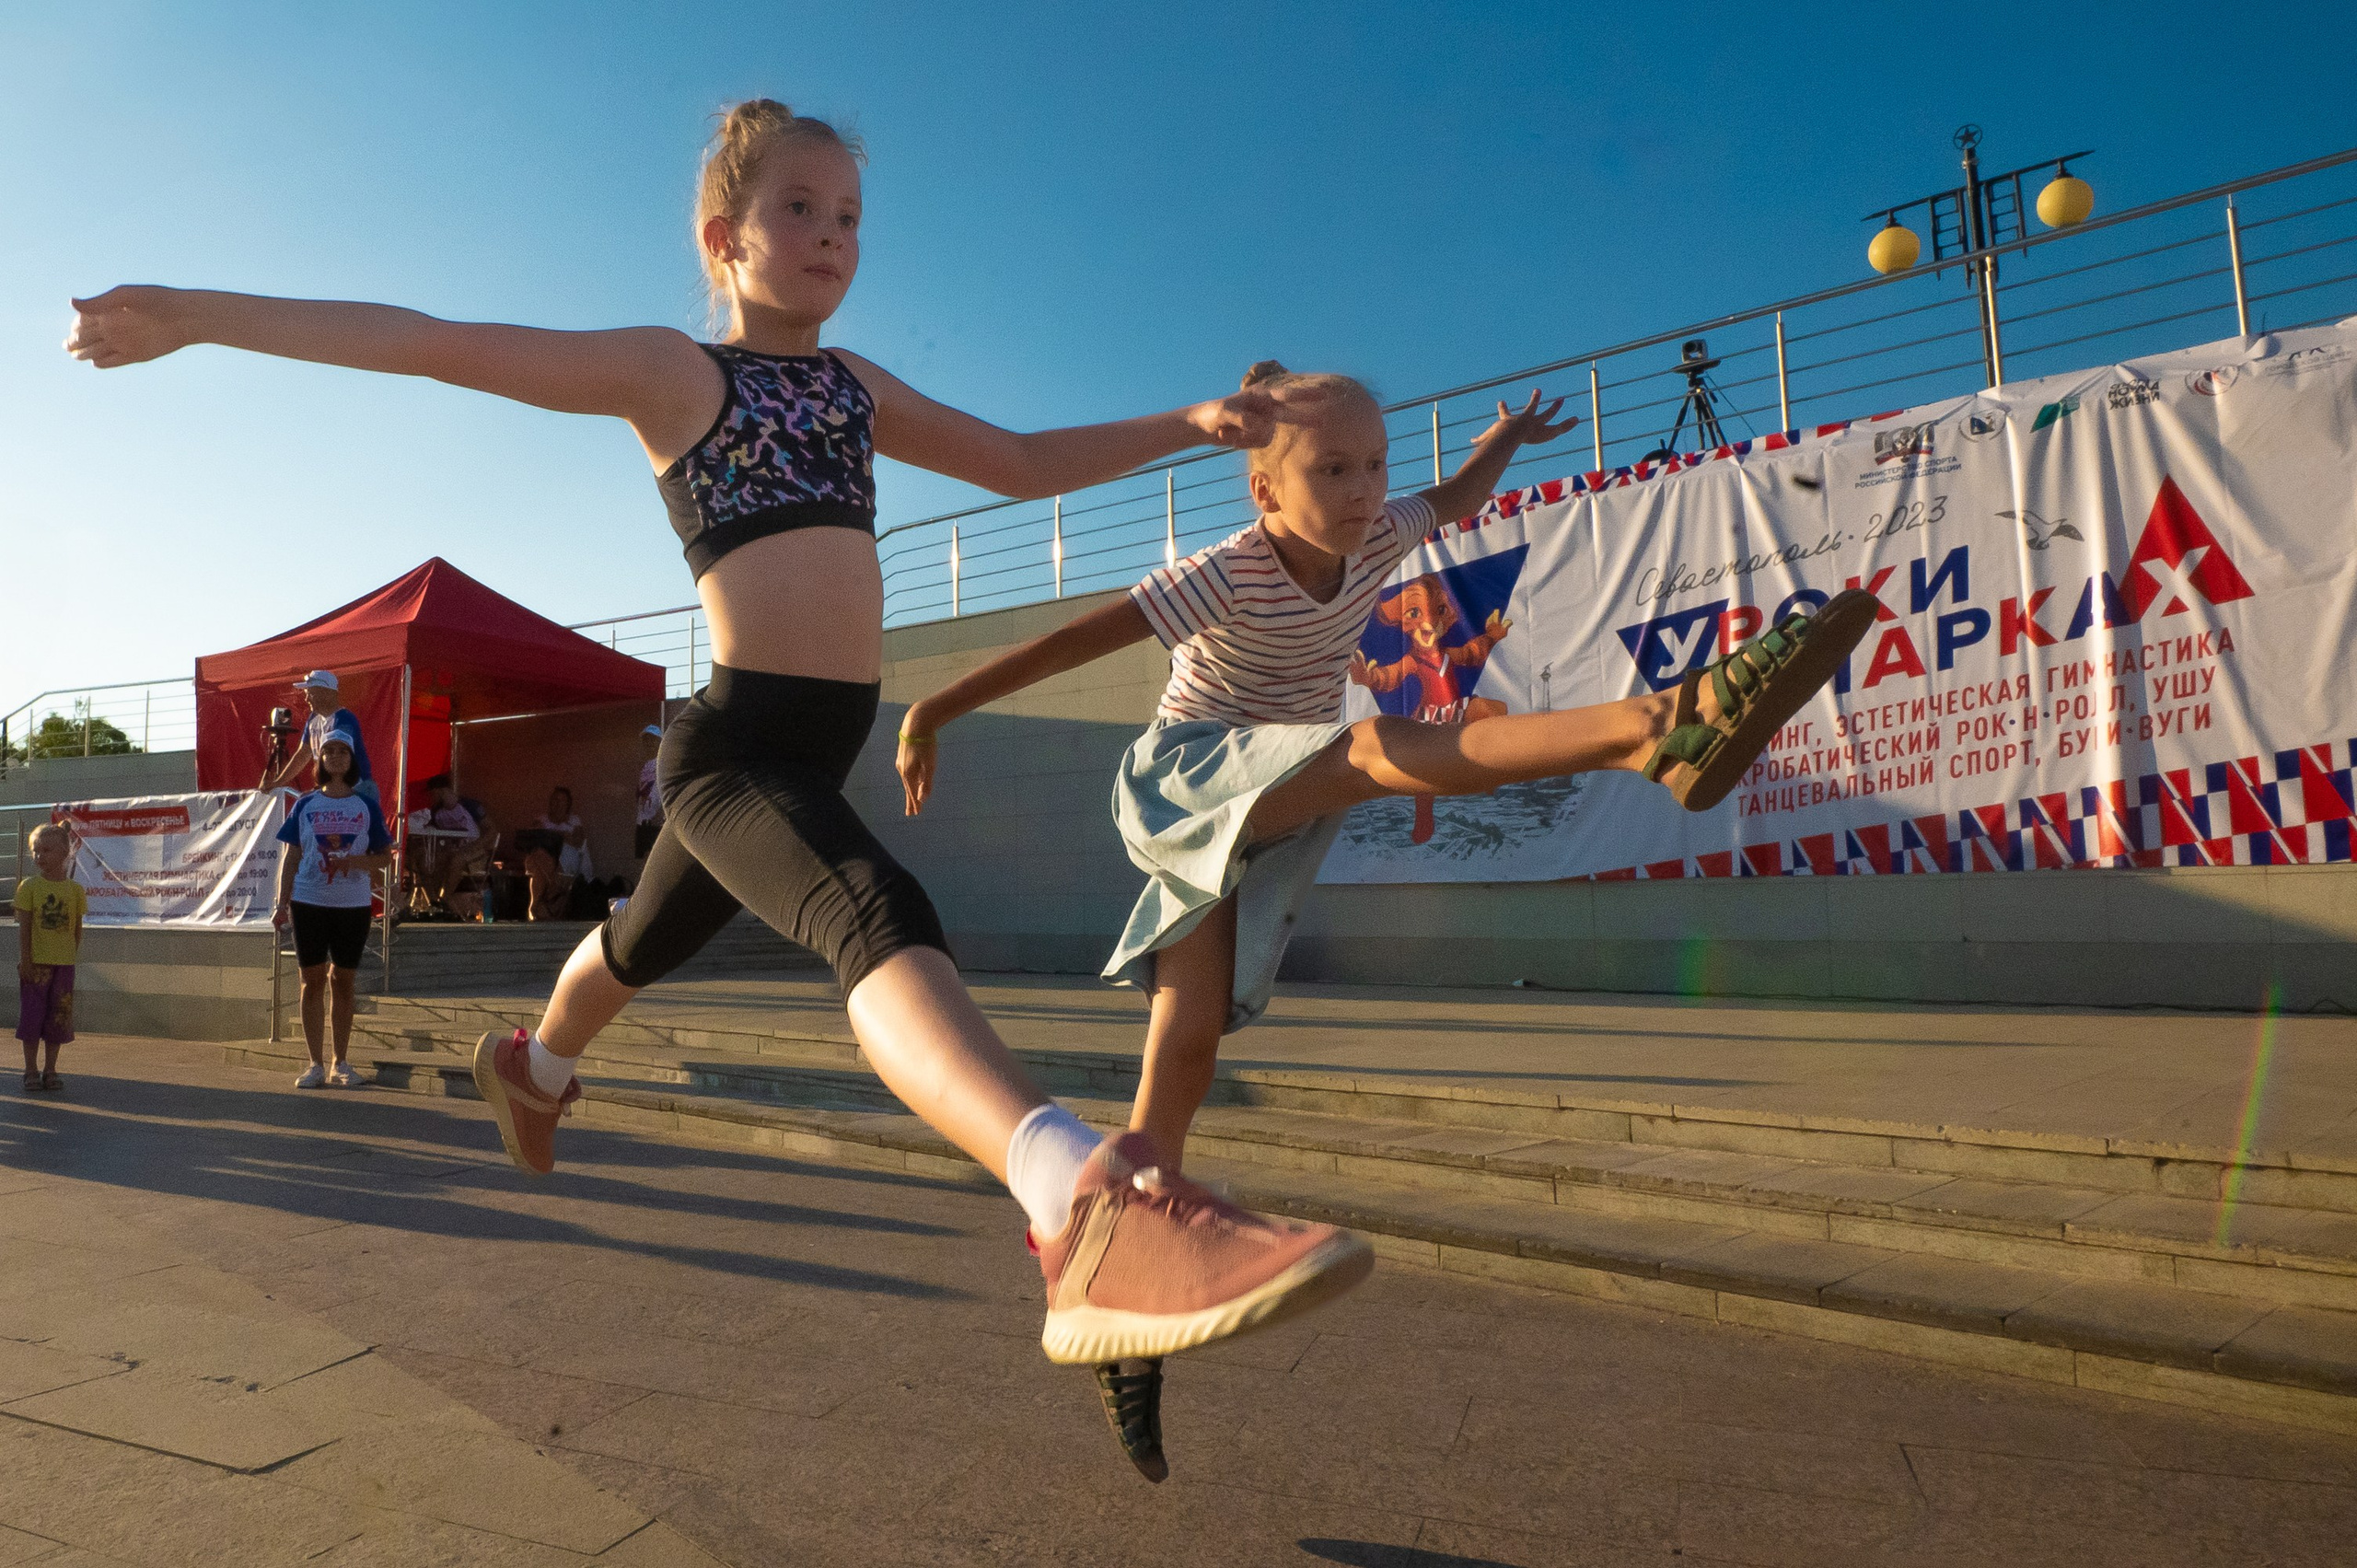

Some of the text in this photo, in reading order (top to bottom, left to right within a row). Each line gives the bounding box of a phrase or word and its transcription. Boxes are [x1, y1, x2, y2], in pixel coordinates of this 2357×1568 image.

[1864, 495, 1947, 542] 2023
[1834, 543, 2217, 695] АРКАХ
[1835, 673, 2030, 738] ЭСТЕТИЧЕСКАЯ
[2153, 666, 2216, 703] УШУ
[1738, 755, 1933, 818] ТАНЦЕВАЛЬНЫЙ
[1949, 739, 2042, 779] СПОРТ,
